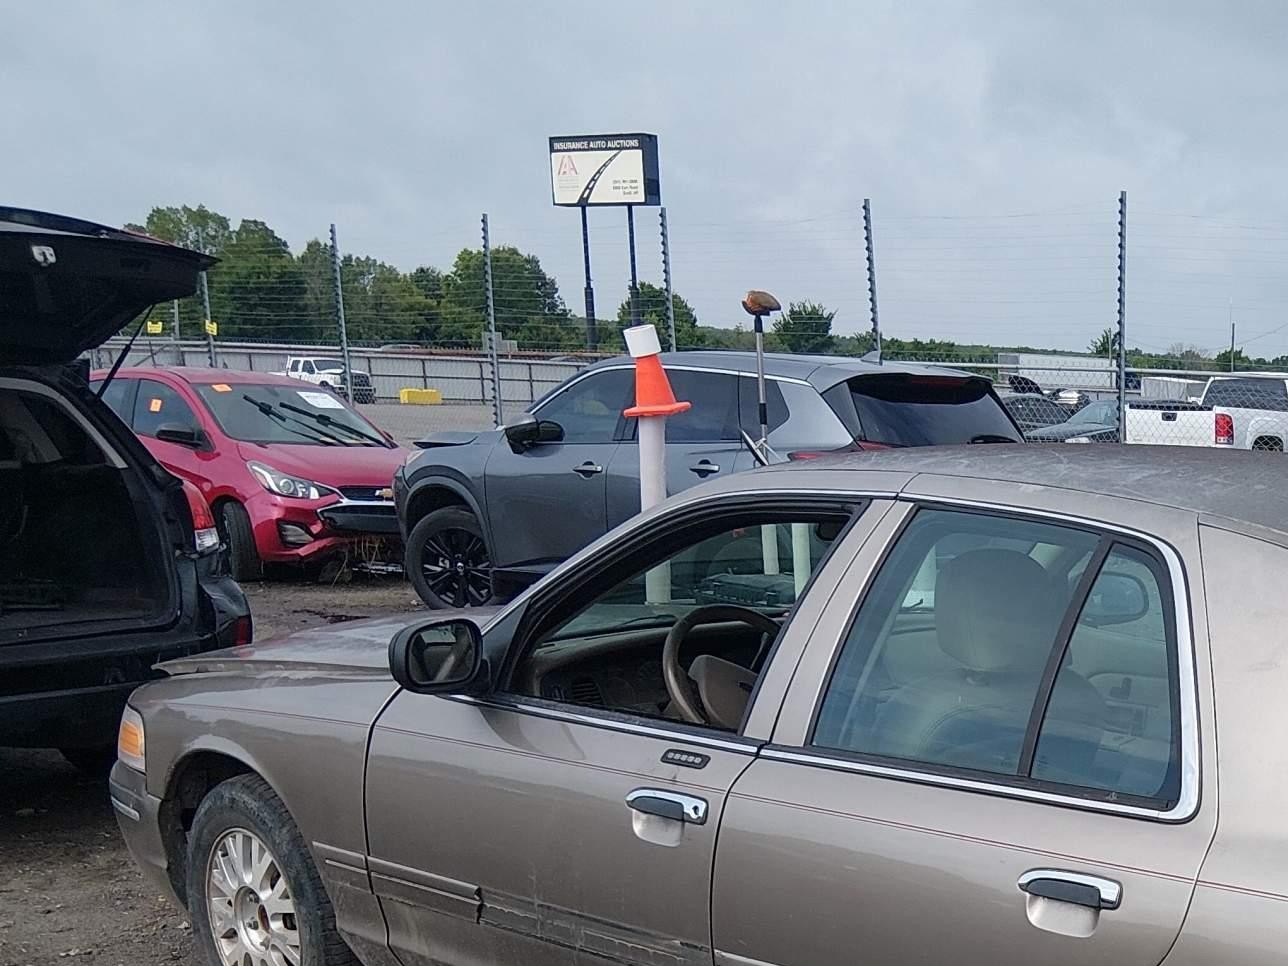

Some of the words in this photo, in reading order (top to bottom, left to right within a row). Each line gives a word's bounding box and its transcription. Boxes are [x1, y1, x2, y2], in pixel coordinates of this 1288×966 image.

[553, 141, 589, 150] INSURANCE
[589, 140, 606, 148] AUTO
[607, 139, 639, 147] AUCTIONS
